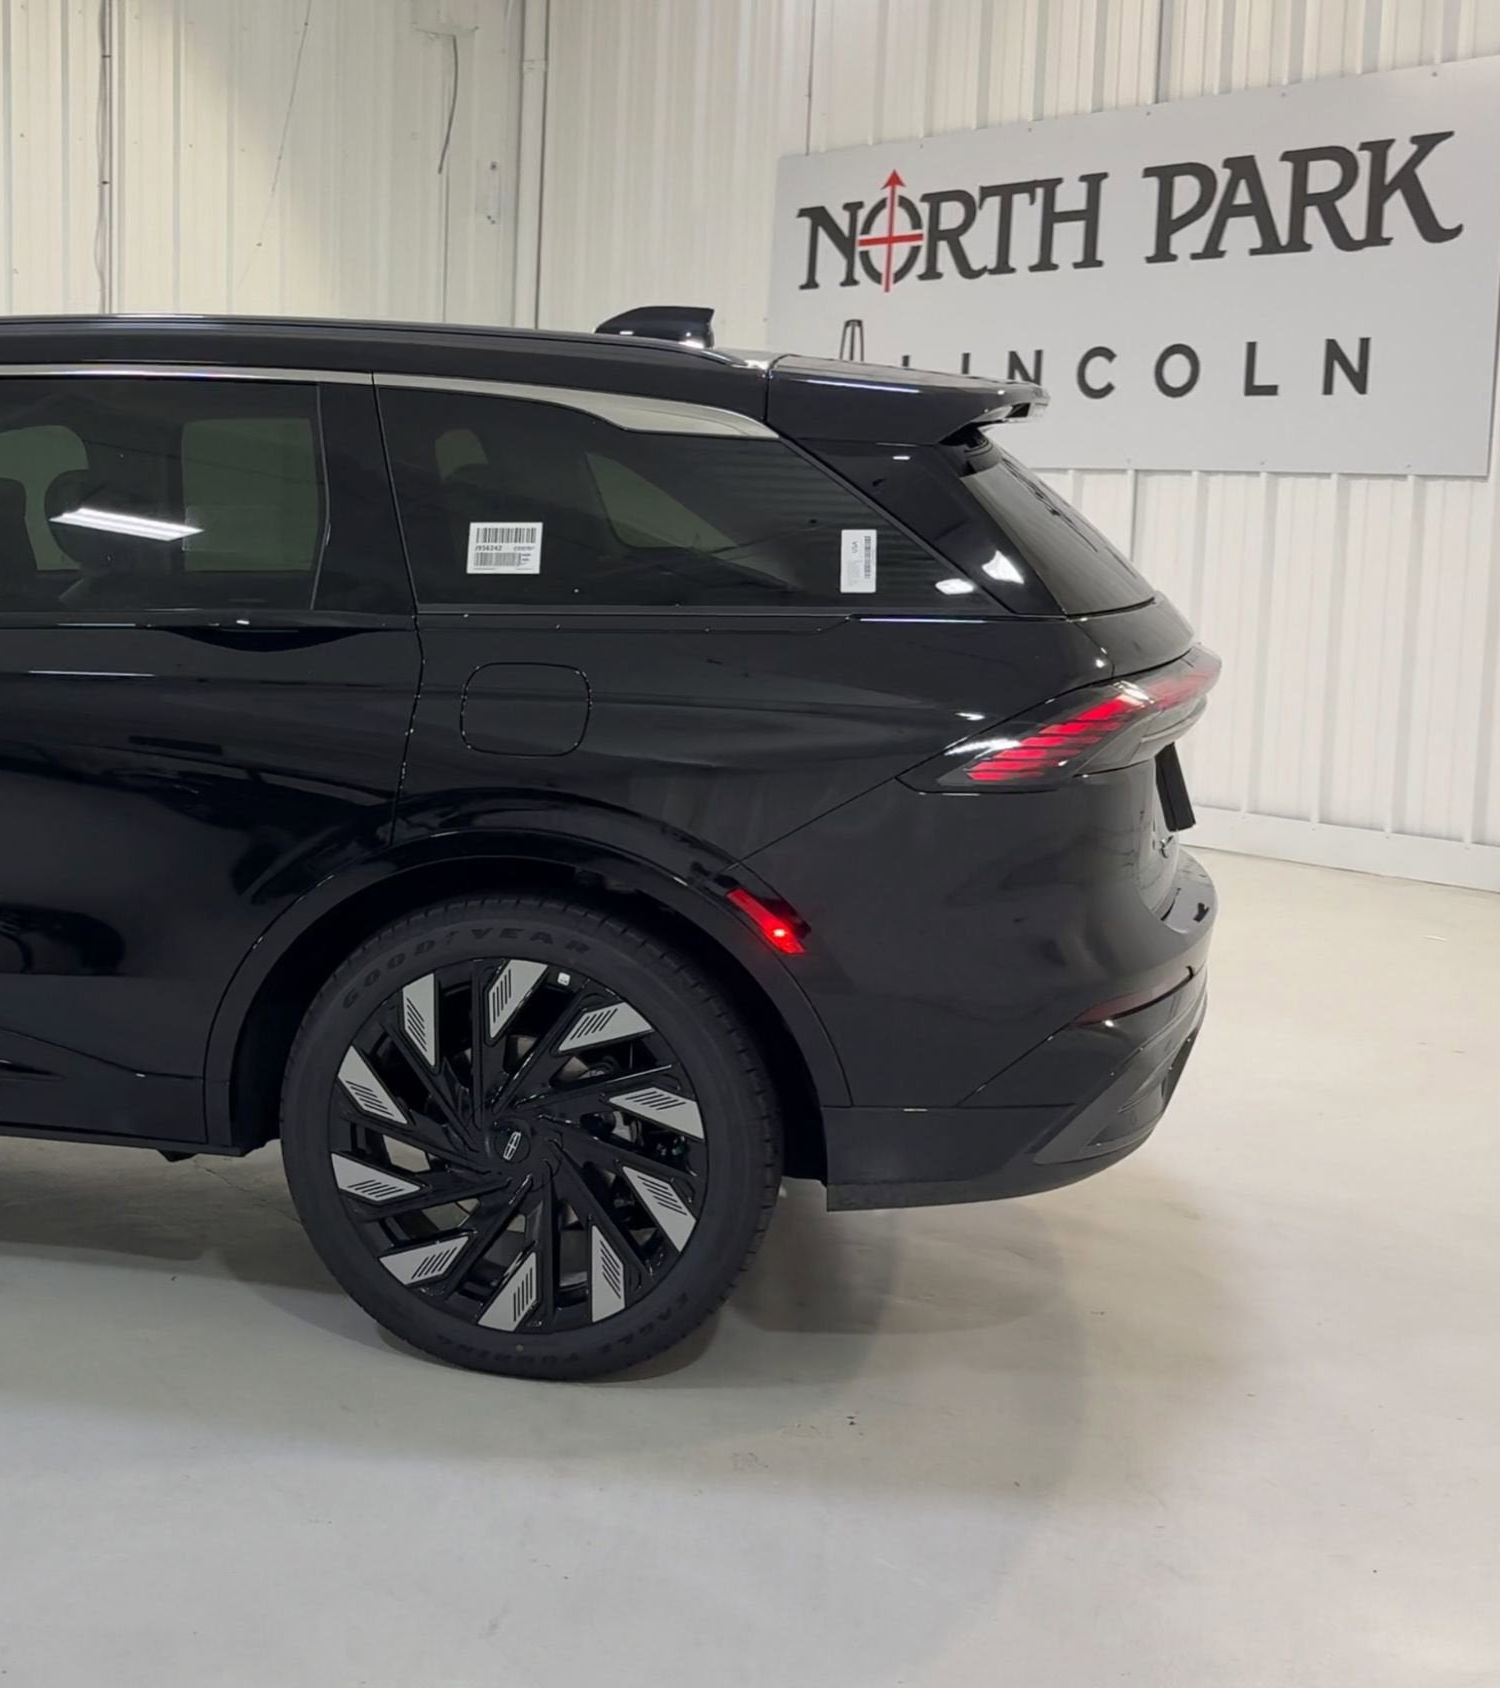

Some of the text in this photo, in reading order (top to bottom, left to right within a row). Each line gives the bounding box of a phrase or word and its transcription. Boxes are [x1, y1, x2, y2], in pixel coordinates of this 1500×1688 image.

[797, 131, 1464, 290] NORTH PARK
[902, 336, 1372, 400] NCOLN
